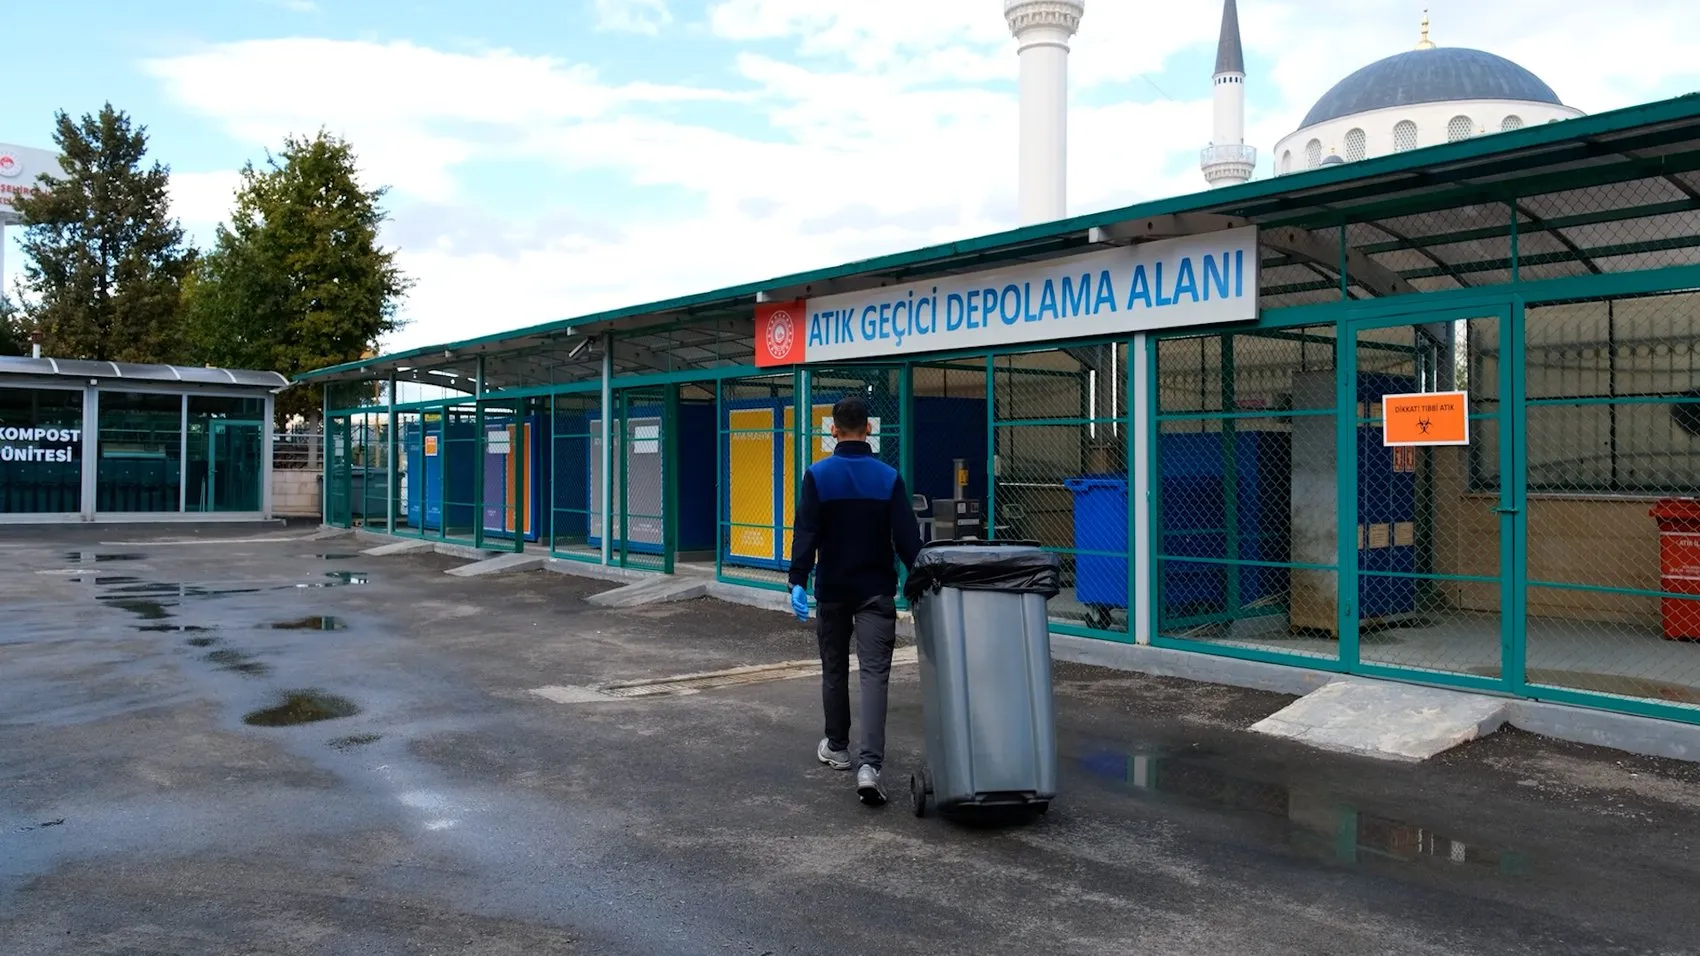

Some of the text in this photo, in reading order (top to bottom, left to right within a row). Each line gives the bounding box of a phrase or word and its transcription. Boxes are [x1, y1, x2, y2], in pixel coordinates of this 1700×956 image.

[808, 250, 1243, 347] ATIK GEÇİCİ DEPOLAMA ALANI
[1, 445, 72, 462] ÜNİTESİ
